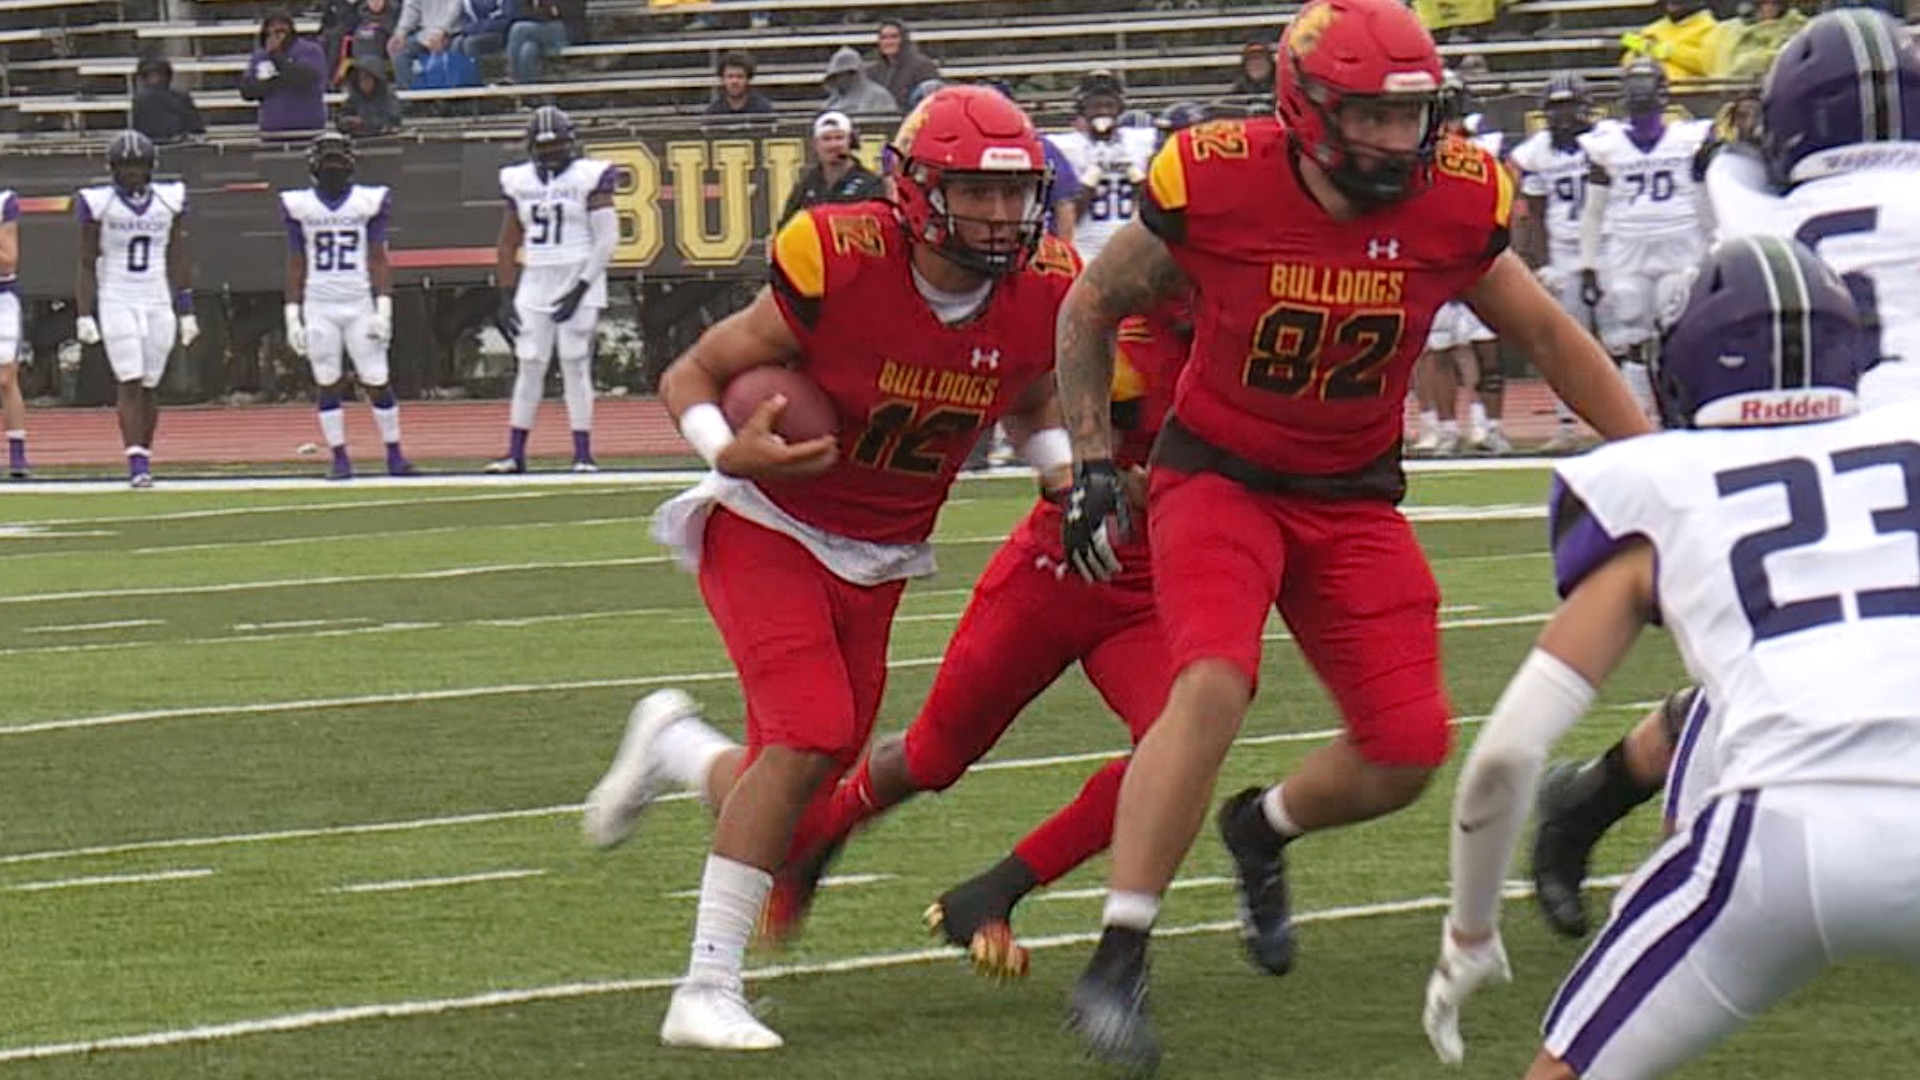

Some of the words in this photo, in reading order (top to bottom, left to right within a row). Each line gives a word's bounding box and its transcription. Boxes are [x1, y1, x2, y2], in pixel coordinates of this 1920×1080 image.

[1625, 170, 1673, 205] 70
[531, 202, 564, 246] 51
[127, 235, 151, 272] 0
[314, 230, 359, 271] 82
[1270, 263, 1404, 305] BULLDOGS
[1242, 301, 1404, 402] 82
[877, 357, 1000, 406] BULLDOGS
[1741, 395, 1841, 421] Riddell
[850, 396, 986, 479] 12
[1713, 440, 1920, 645] 23
